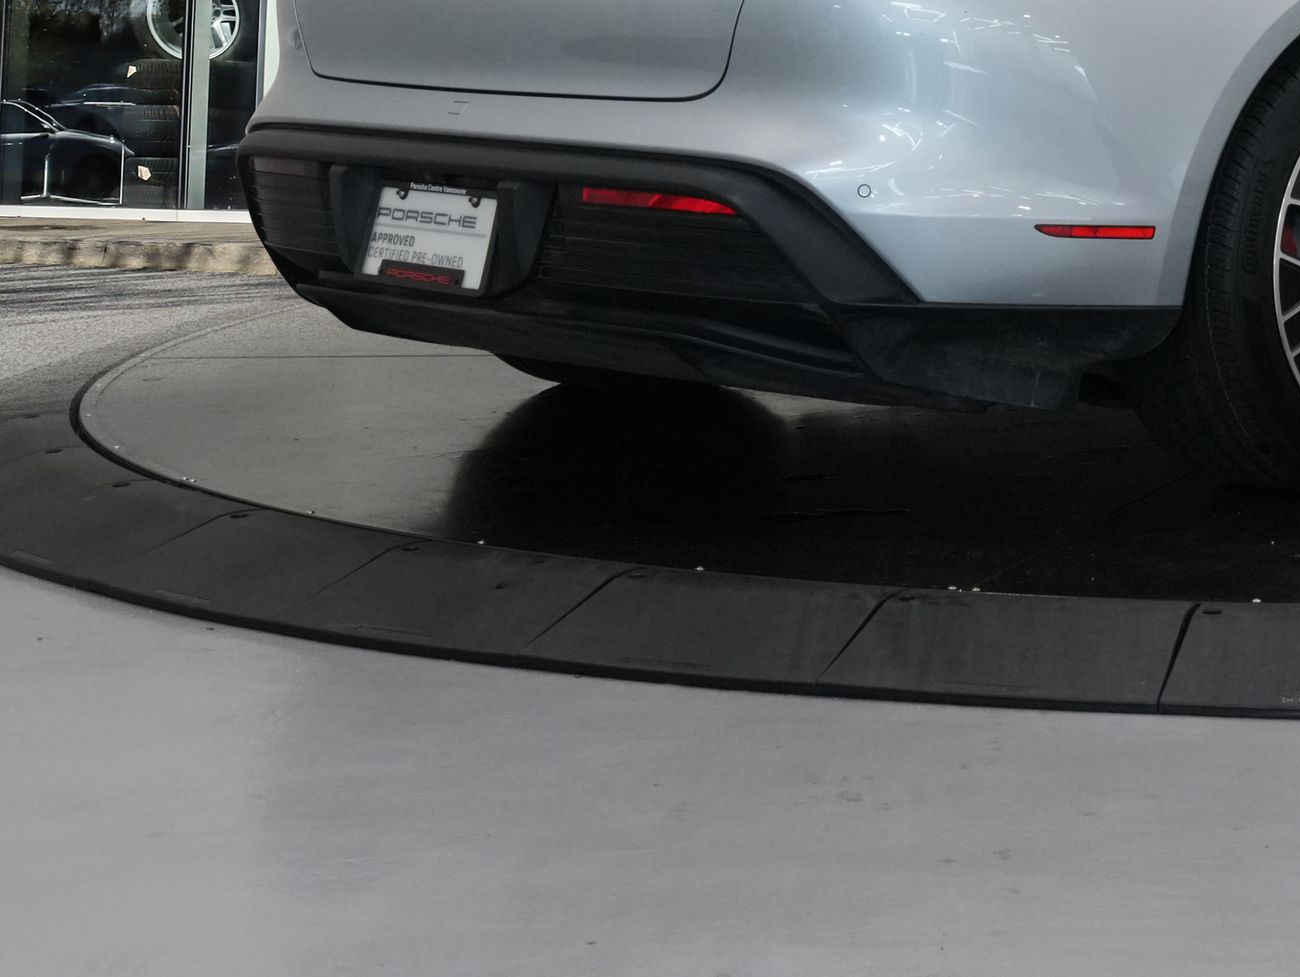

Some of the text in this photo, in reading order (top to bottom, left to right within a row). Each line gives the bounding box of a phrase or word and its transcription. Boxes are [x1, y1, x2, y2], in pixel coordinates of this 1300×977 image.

[410, 182, 467, 194] Porsche Centre Vancouver
[377, 207, 477, 228] PORSCHE
[371, 232, 415, 247] APPROVED
[368, 247, 464, 268] CERTIFIED PRE-OWNED
[387, 268, 450, 284] PORSCHE
